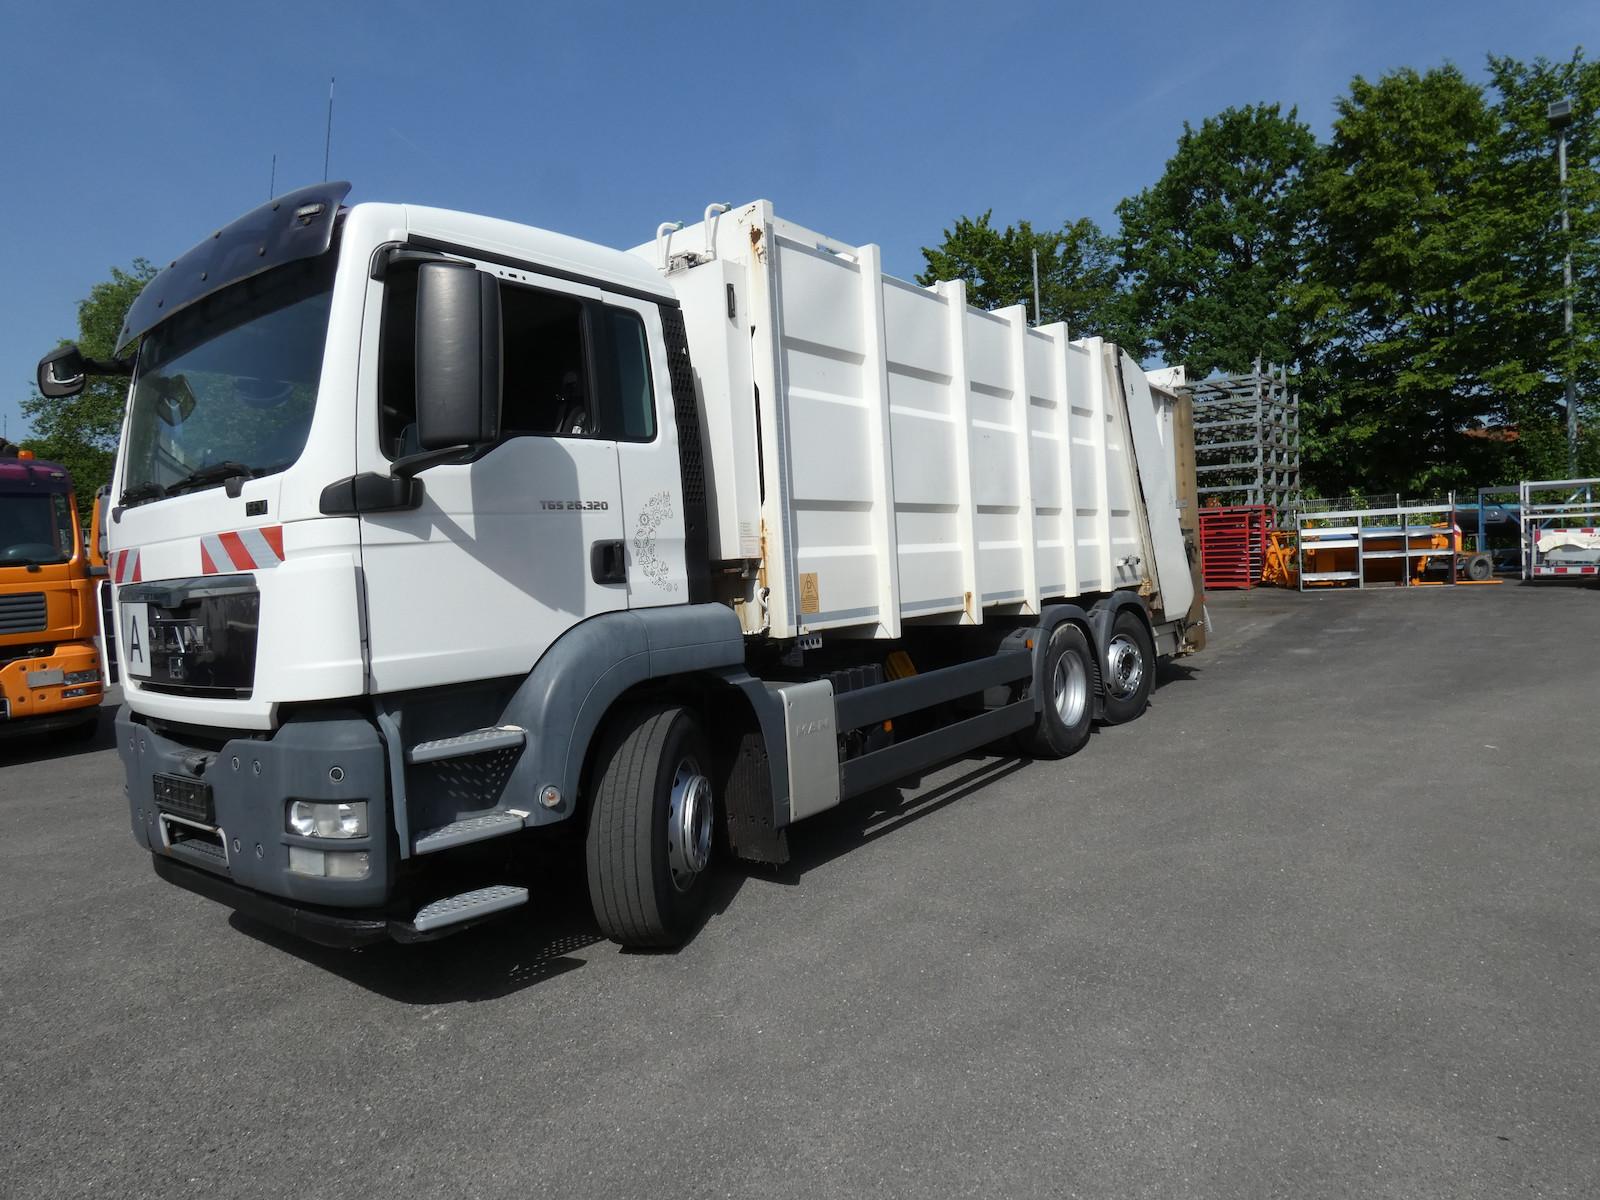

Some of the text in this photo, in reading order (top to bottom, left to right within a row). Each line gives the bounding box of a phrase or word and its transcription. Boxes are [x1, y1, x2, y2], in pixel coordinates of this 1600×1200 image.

[540, 500, 609, 511] TGS 26.320
[130, 614, 144, 664] A
